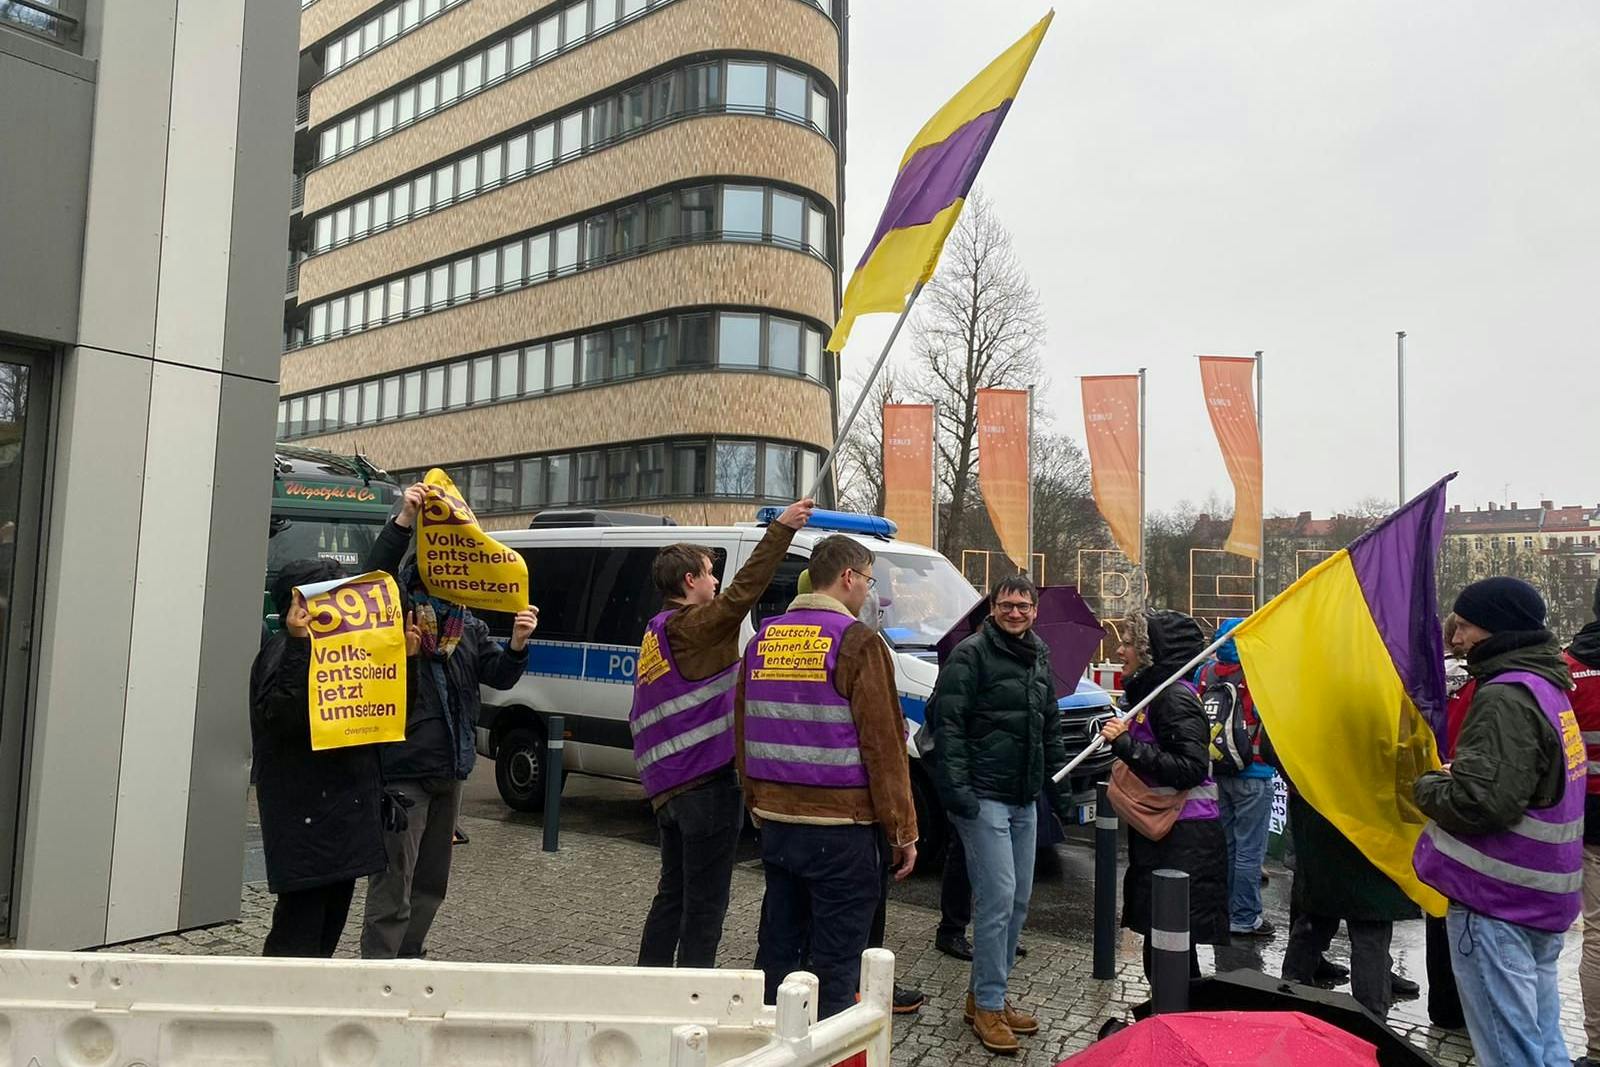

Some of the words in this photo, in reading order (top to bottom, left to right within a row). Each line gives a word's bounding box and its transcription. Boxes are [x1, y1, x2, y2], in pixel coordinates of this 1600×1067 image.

[346, 485, 356, 498] &
[357, 487, 375, 501] Co
[425, 532, 484, 549] Volks-
[427, 548, 517, 564] entscheid
[427, 562, 470, 577] jetzt
[430, 578, 520, 593] umsetzen
[767, 627, 817, 637] Deutsche
[314, 644, 372, 664] Volks-
[759, 641, 801, 653] Wohnen
[803, 640, 811, 650] &
[813, 639, 829, 650] Co
[767, 654, 823, 668] enteignen!
[316, 663, 397, 683] entscheid
[318, 683, 364, 706] jetzt
[320, 702, 396, 721] umsetzen
